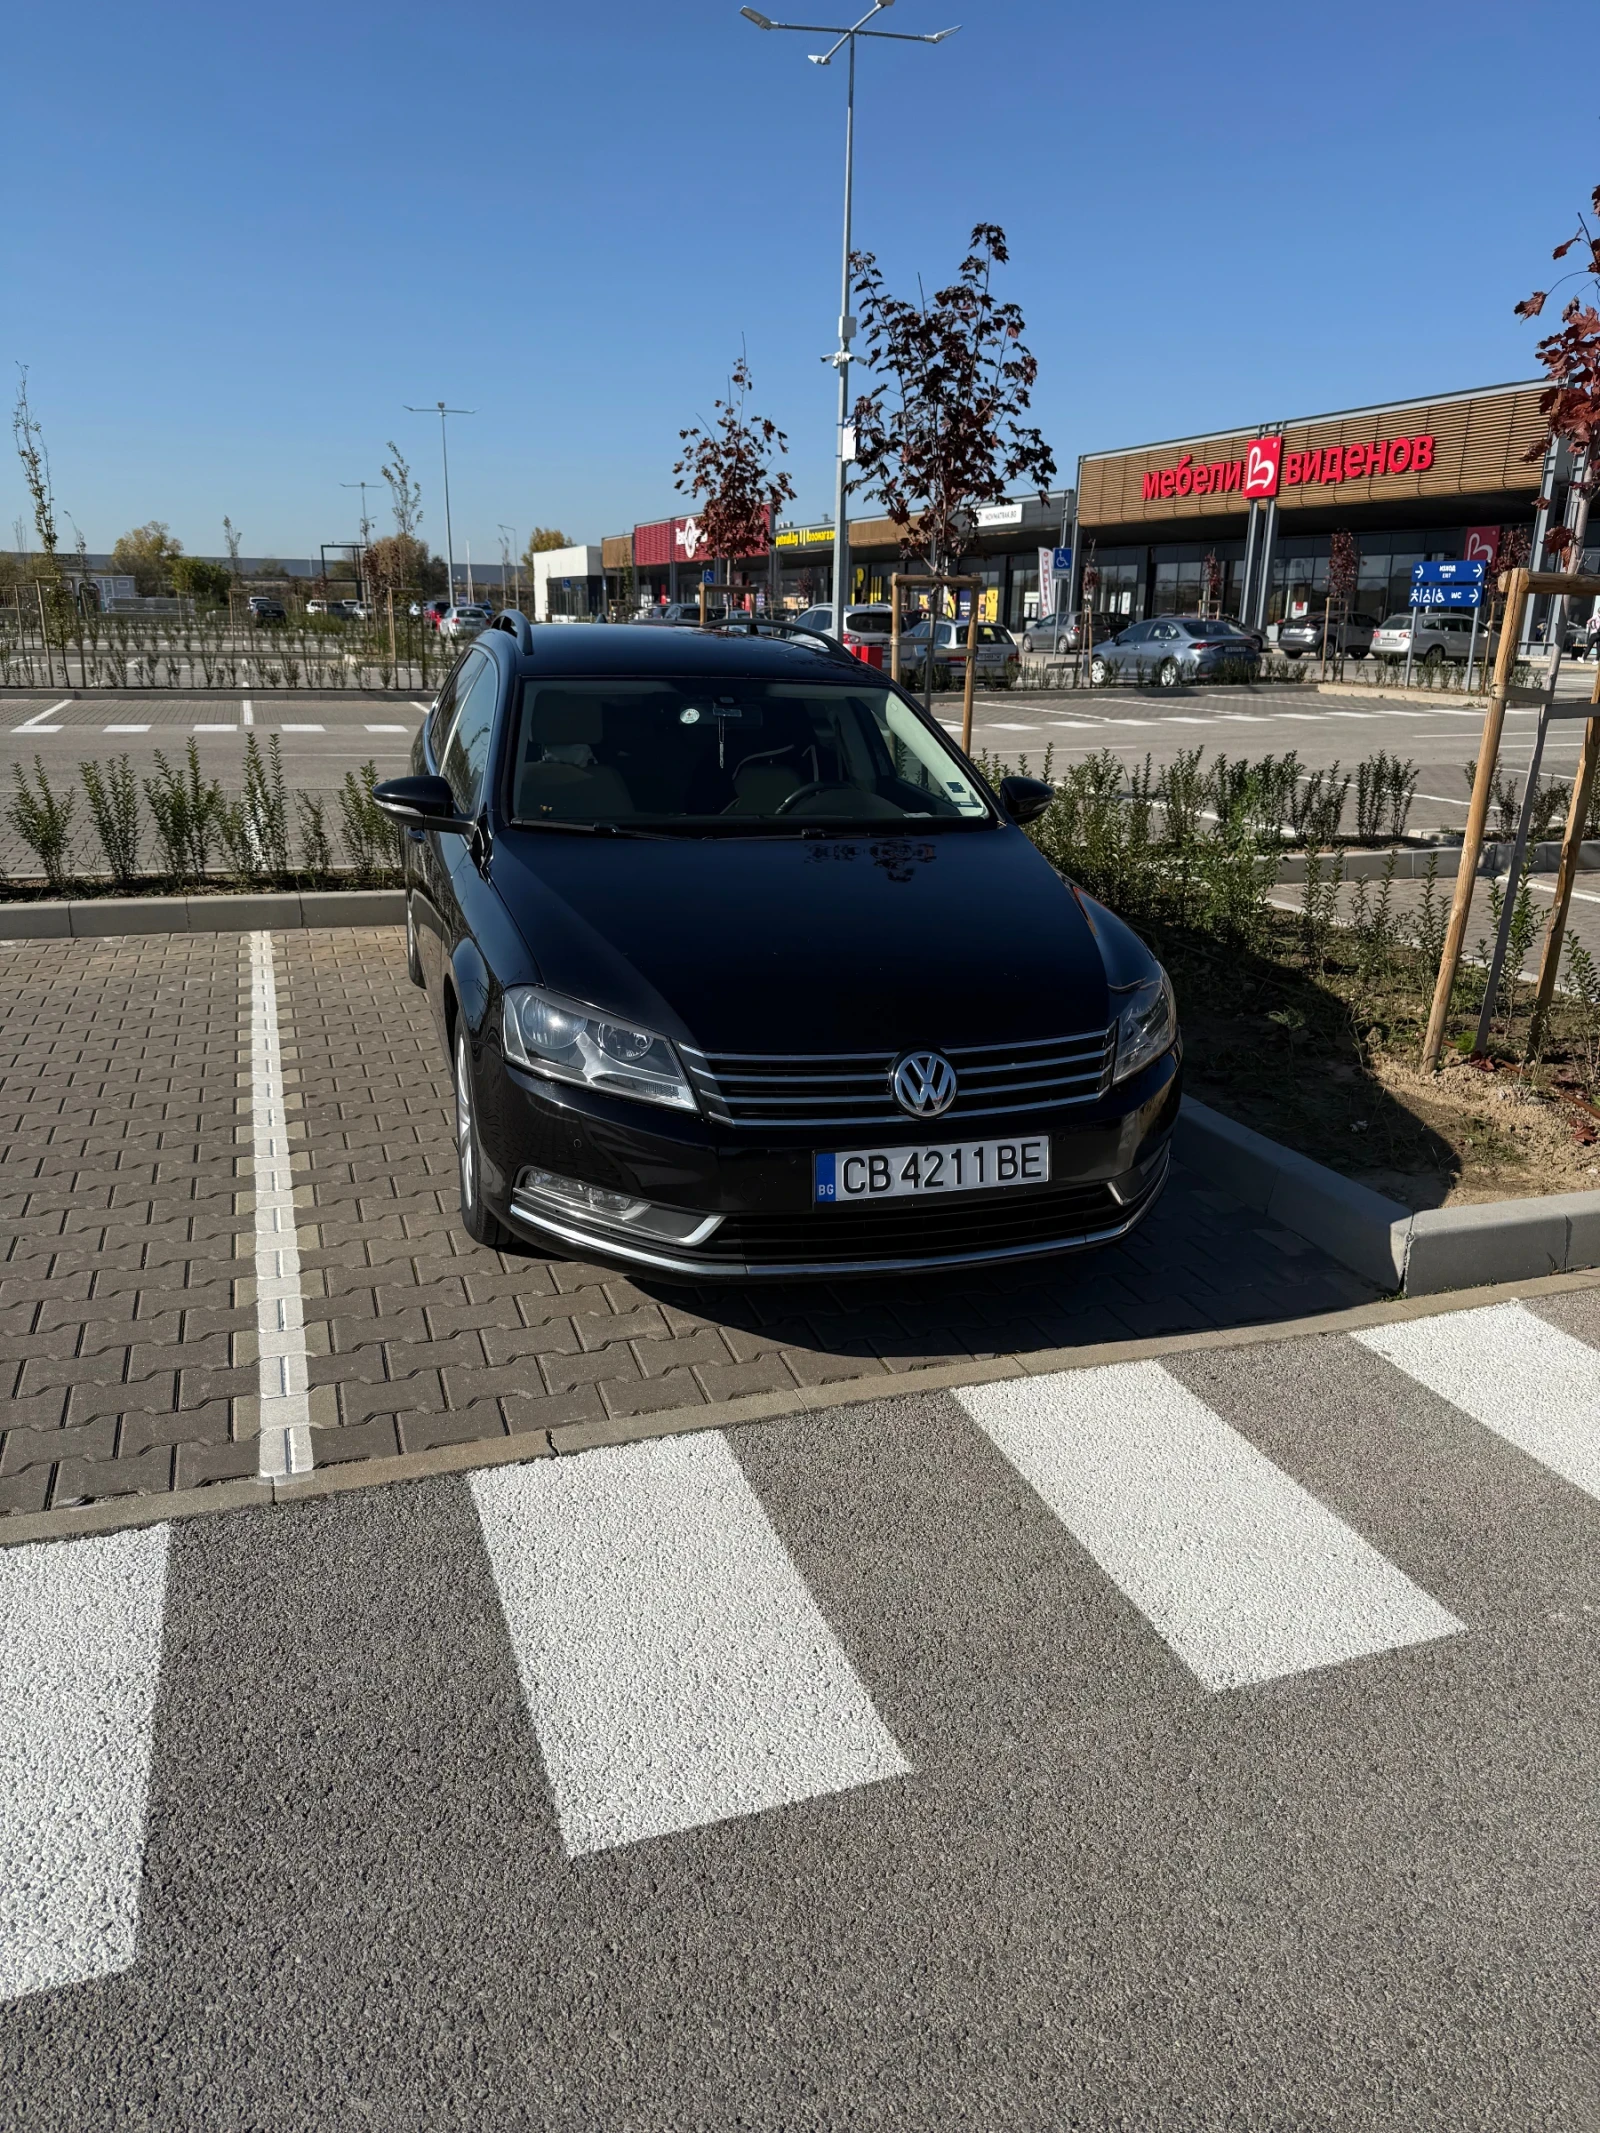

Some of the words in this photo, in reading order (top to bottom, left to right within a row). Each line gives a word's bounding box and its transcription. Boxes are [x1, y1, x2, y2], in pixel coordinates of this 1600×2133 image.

[1142, 453, 1242, 500] мебели
[1285, 434, 1436, 485] виденов
[1451, 591, 1462, 599] WC
[842, 1154, 891, 1194] CB
[899, 1146, 985, 1189] 4211
[996, 1142, 1042, 1181] BE
[818, 1183, 835, 1196] BG
